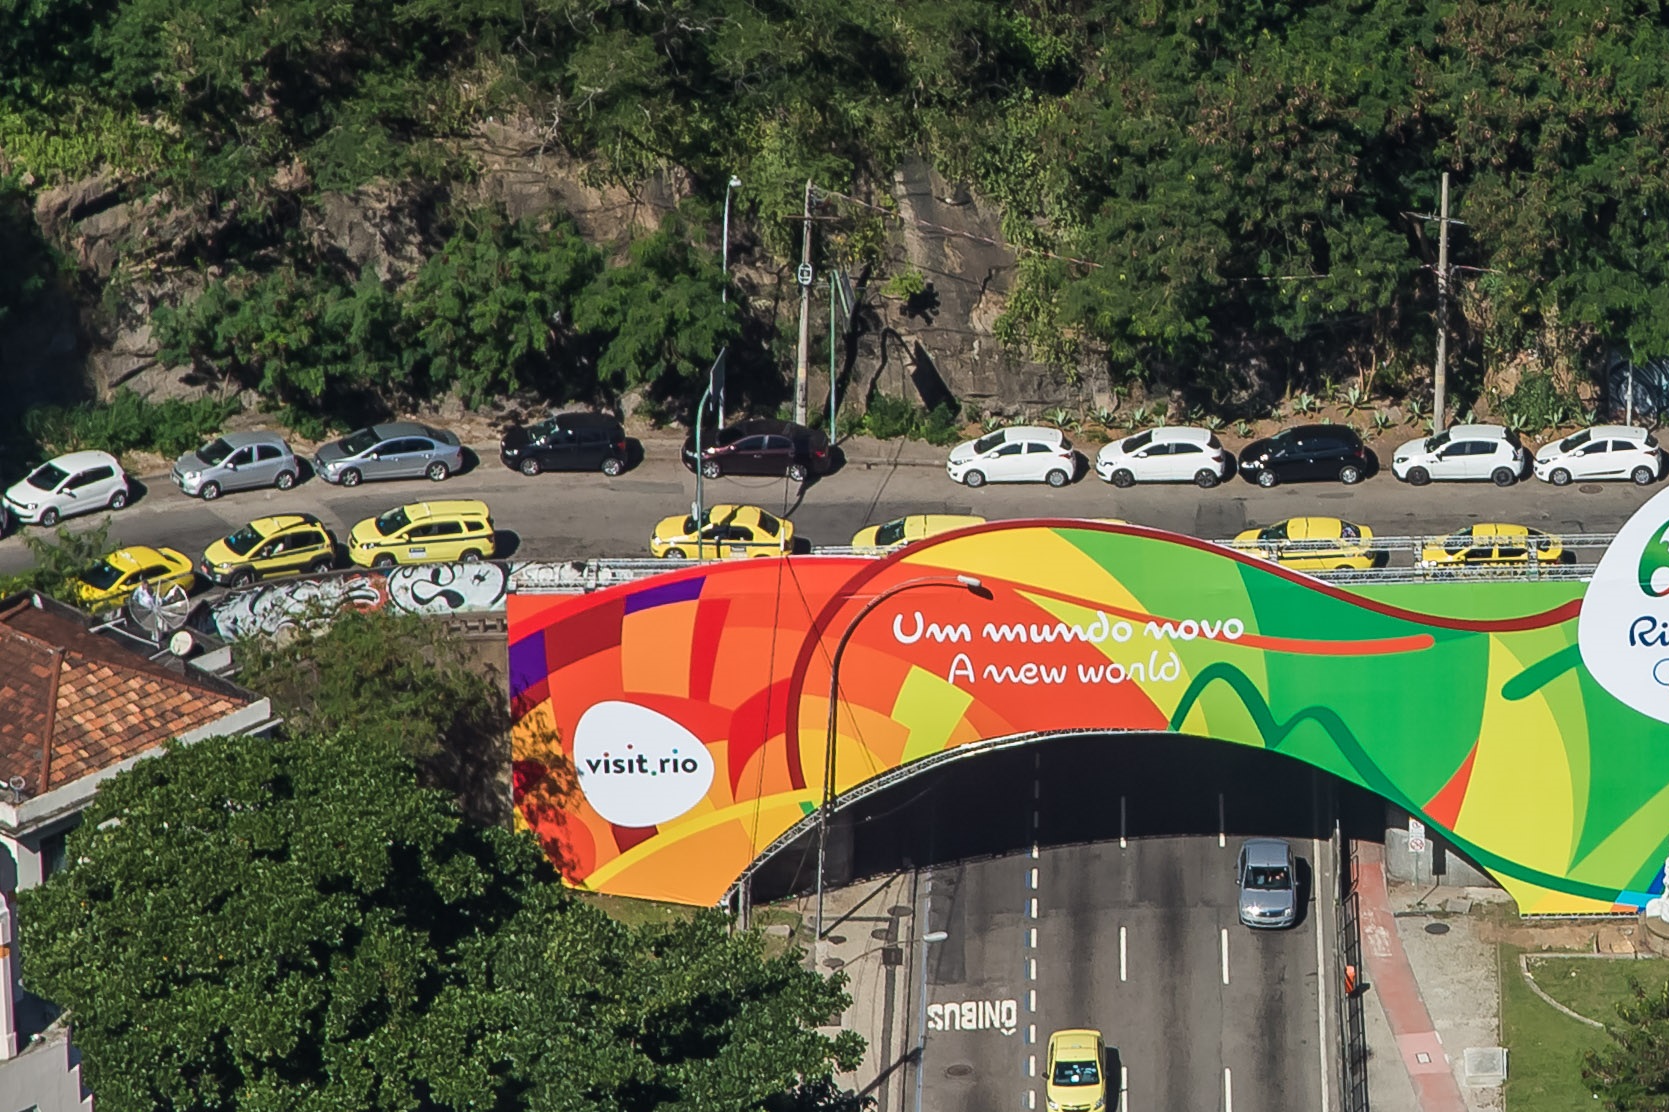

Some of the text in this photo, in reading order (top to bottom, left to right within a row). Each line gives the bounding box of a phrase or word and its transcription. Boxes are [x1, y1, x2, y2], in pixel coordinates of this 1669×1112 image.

[894, 611, 1243, 643] Um mundo novo
[949, 651, 1180, 684] A new world
[586, 744, 698, 776] visit.rio
[927, 1000, 1017, 1036] ÔNIBUS
